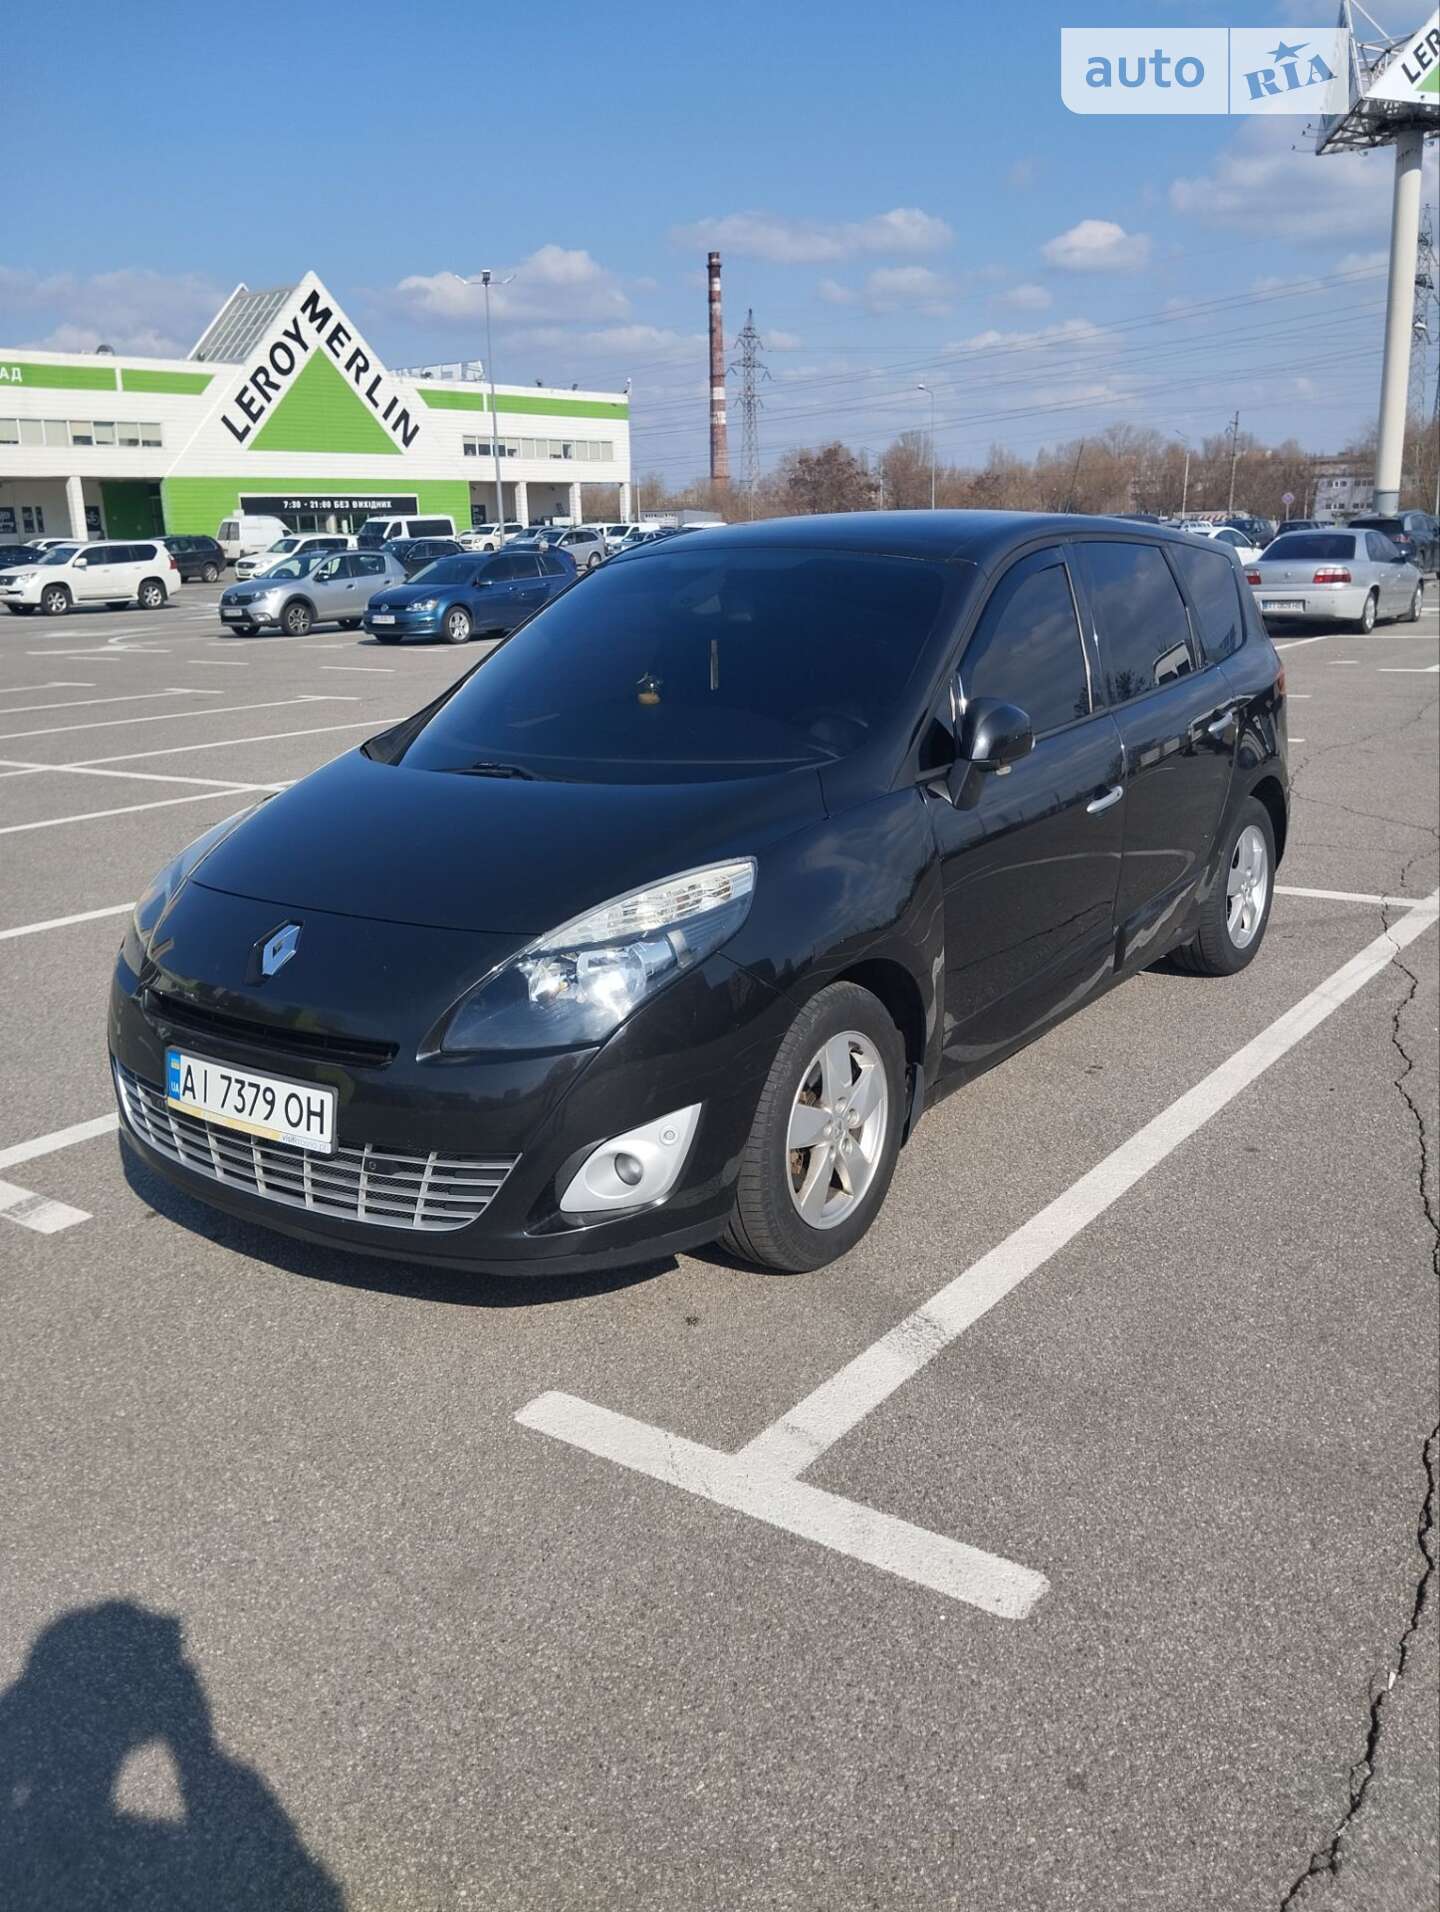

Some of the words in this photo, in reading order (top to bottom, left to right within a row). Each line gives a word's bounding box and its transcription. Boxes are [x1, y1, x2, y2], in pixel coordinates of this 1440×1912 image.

[220, 316, 309, 443] LEROY
[300, 288, 420, 448] MERLIN
[182, 1064, 208, 1103] AI
[220, 1073, 276, 1121] 7379
[284, 1092, 324, 1135] OH
